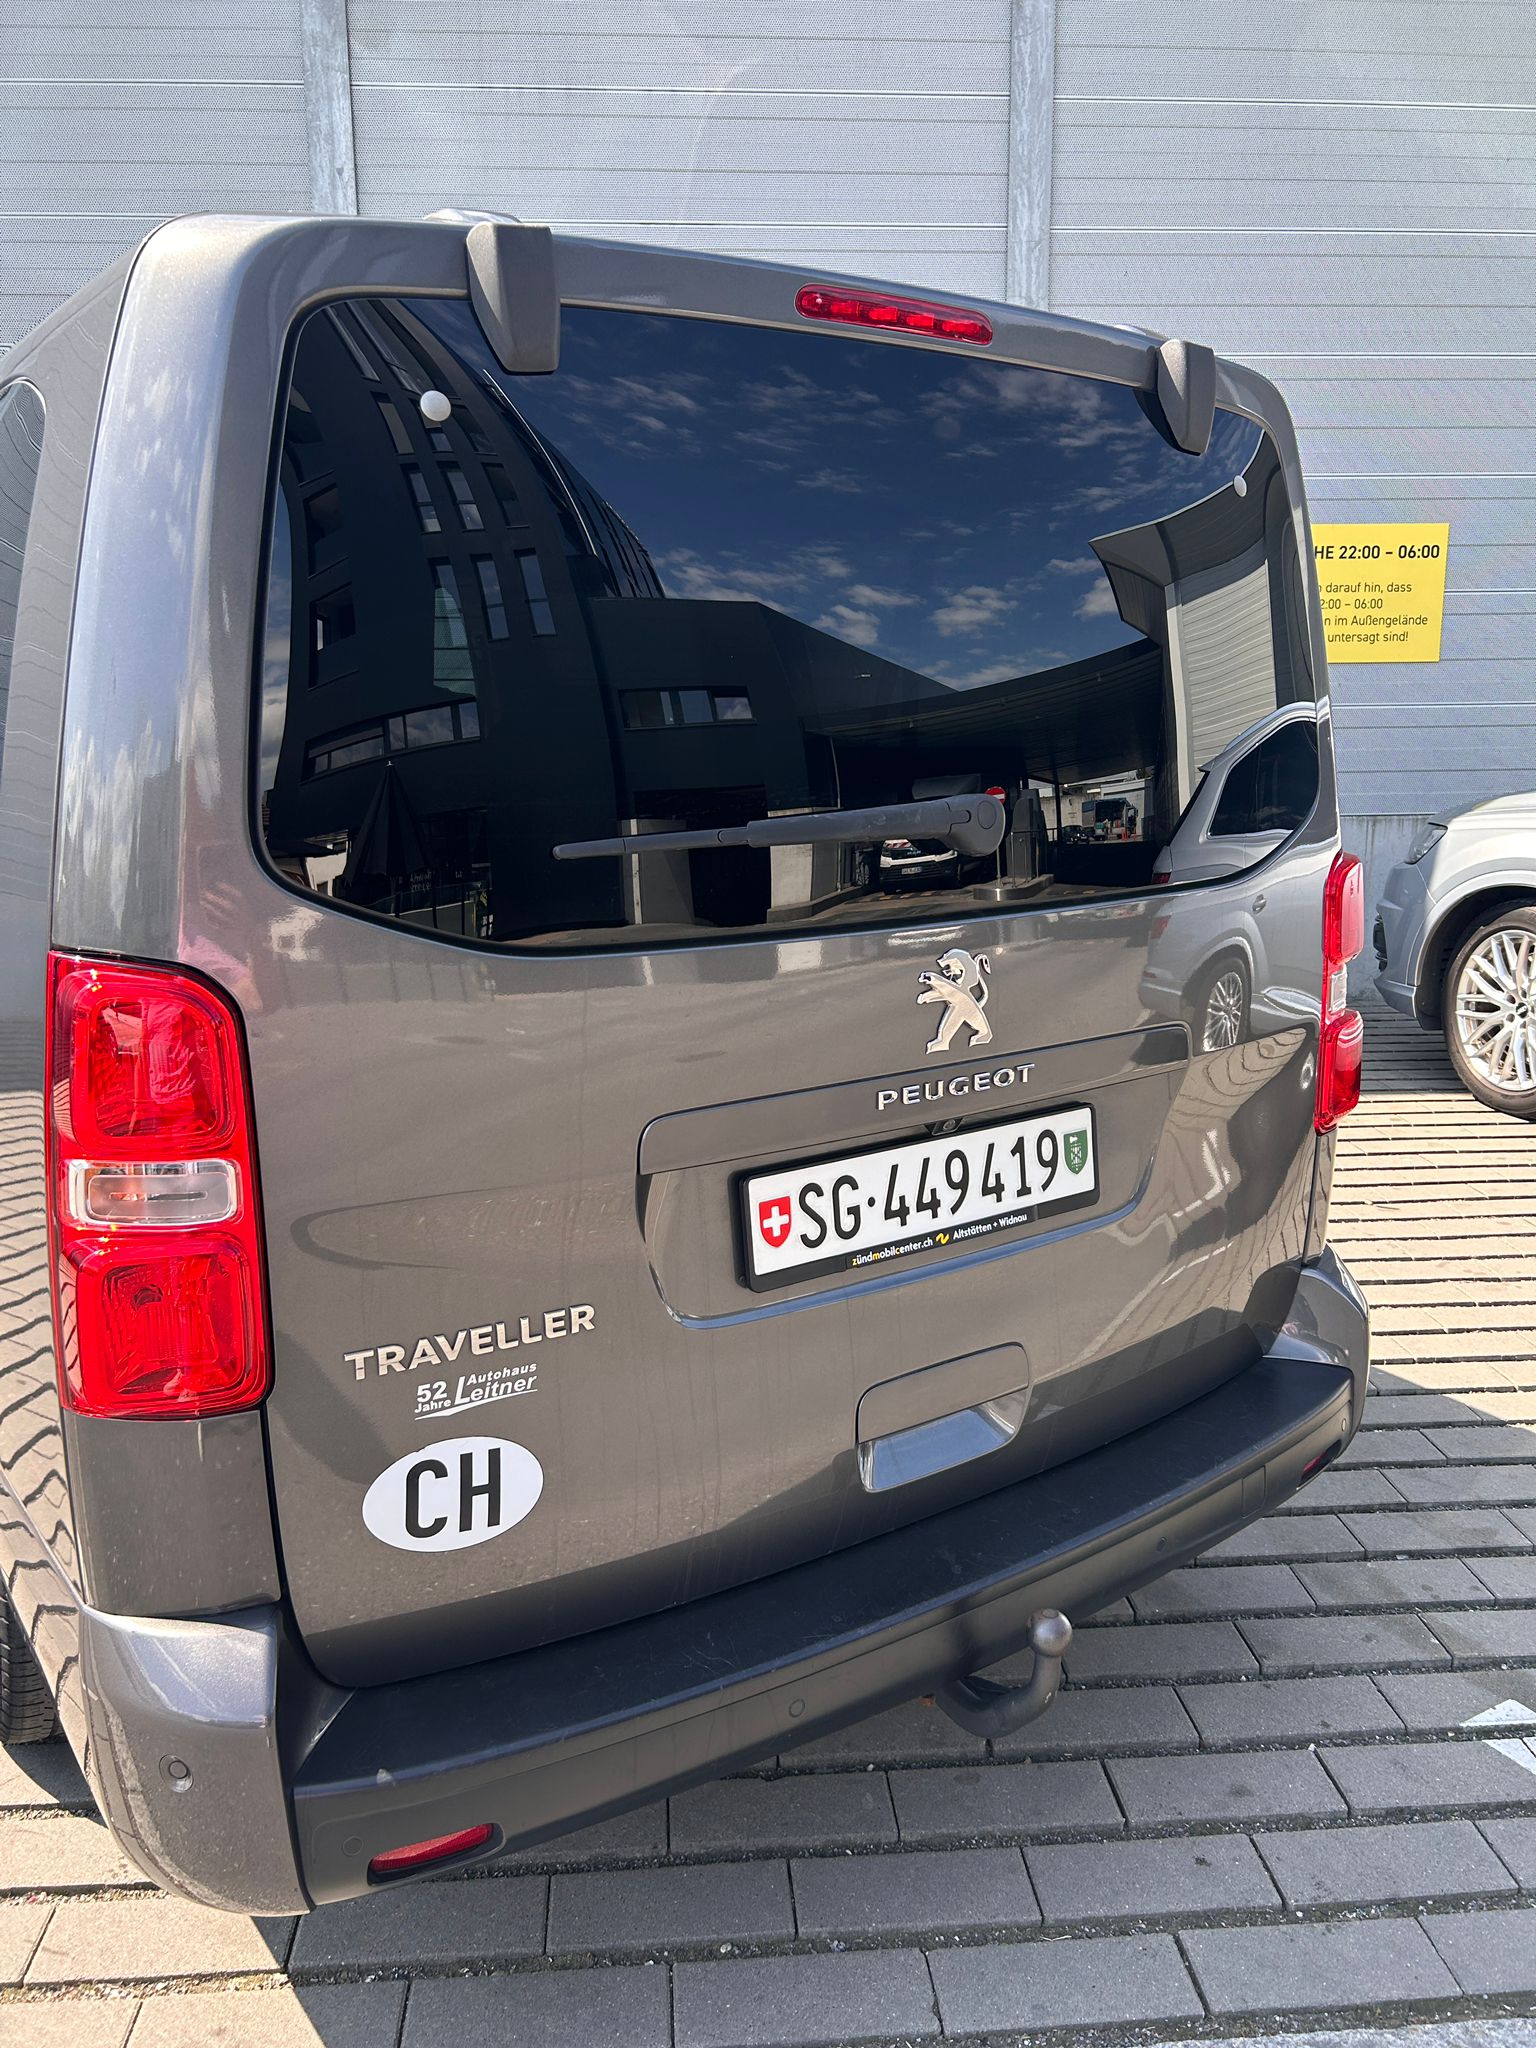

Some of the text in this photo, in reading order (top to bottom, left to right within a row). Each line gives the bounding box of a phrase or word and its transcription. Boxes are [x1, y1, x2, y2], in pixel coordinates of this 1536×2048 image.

[1314, 545, 1335, 559] HE
[1338, 545, 1381, 560] 22:00
[1398, 544, 1440, 559] 06:00
[1325, 581, 1361, 593] darauf
[1364, 581, 1384, 594] hin,
[1386, 581, 1413, 593] dass
[1354, 598, 1384, 610] 06:00
[1334, 615, 1348, 626] im
[1350, 614, 1428, 628] Außengelände
[1327, 631, 1409, 645] untersagt sind!
[876, 1063, 1036, 1111] PEUGEOT
[852, 1236, 934, 1267] zündmobilcenter.ch
[952, 1223, 993, 1241] Altstätten
[998, 1212, 1028, 1228] Widnau
[343, 1303, 596, 1382] TRAVELLER
[466, 1362, 537, 1386] Autohaus
[416, 1380, 448, 1403] 52
[454, 1375, 538, 1406] Leitner
[414, 1399, 452, 1414] Jahre
[405, 1447, 501, 1539] CH
